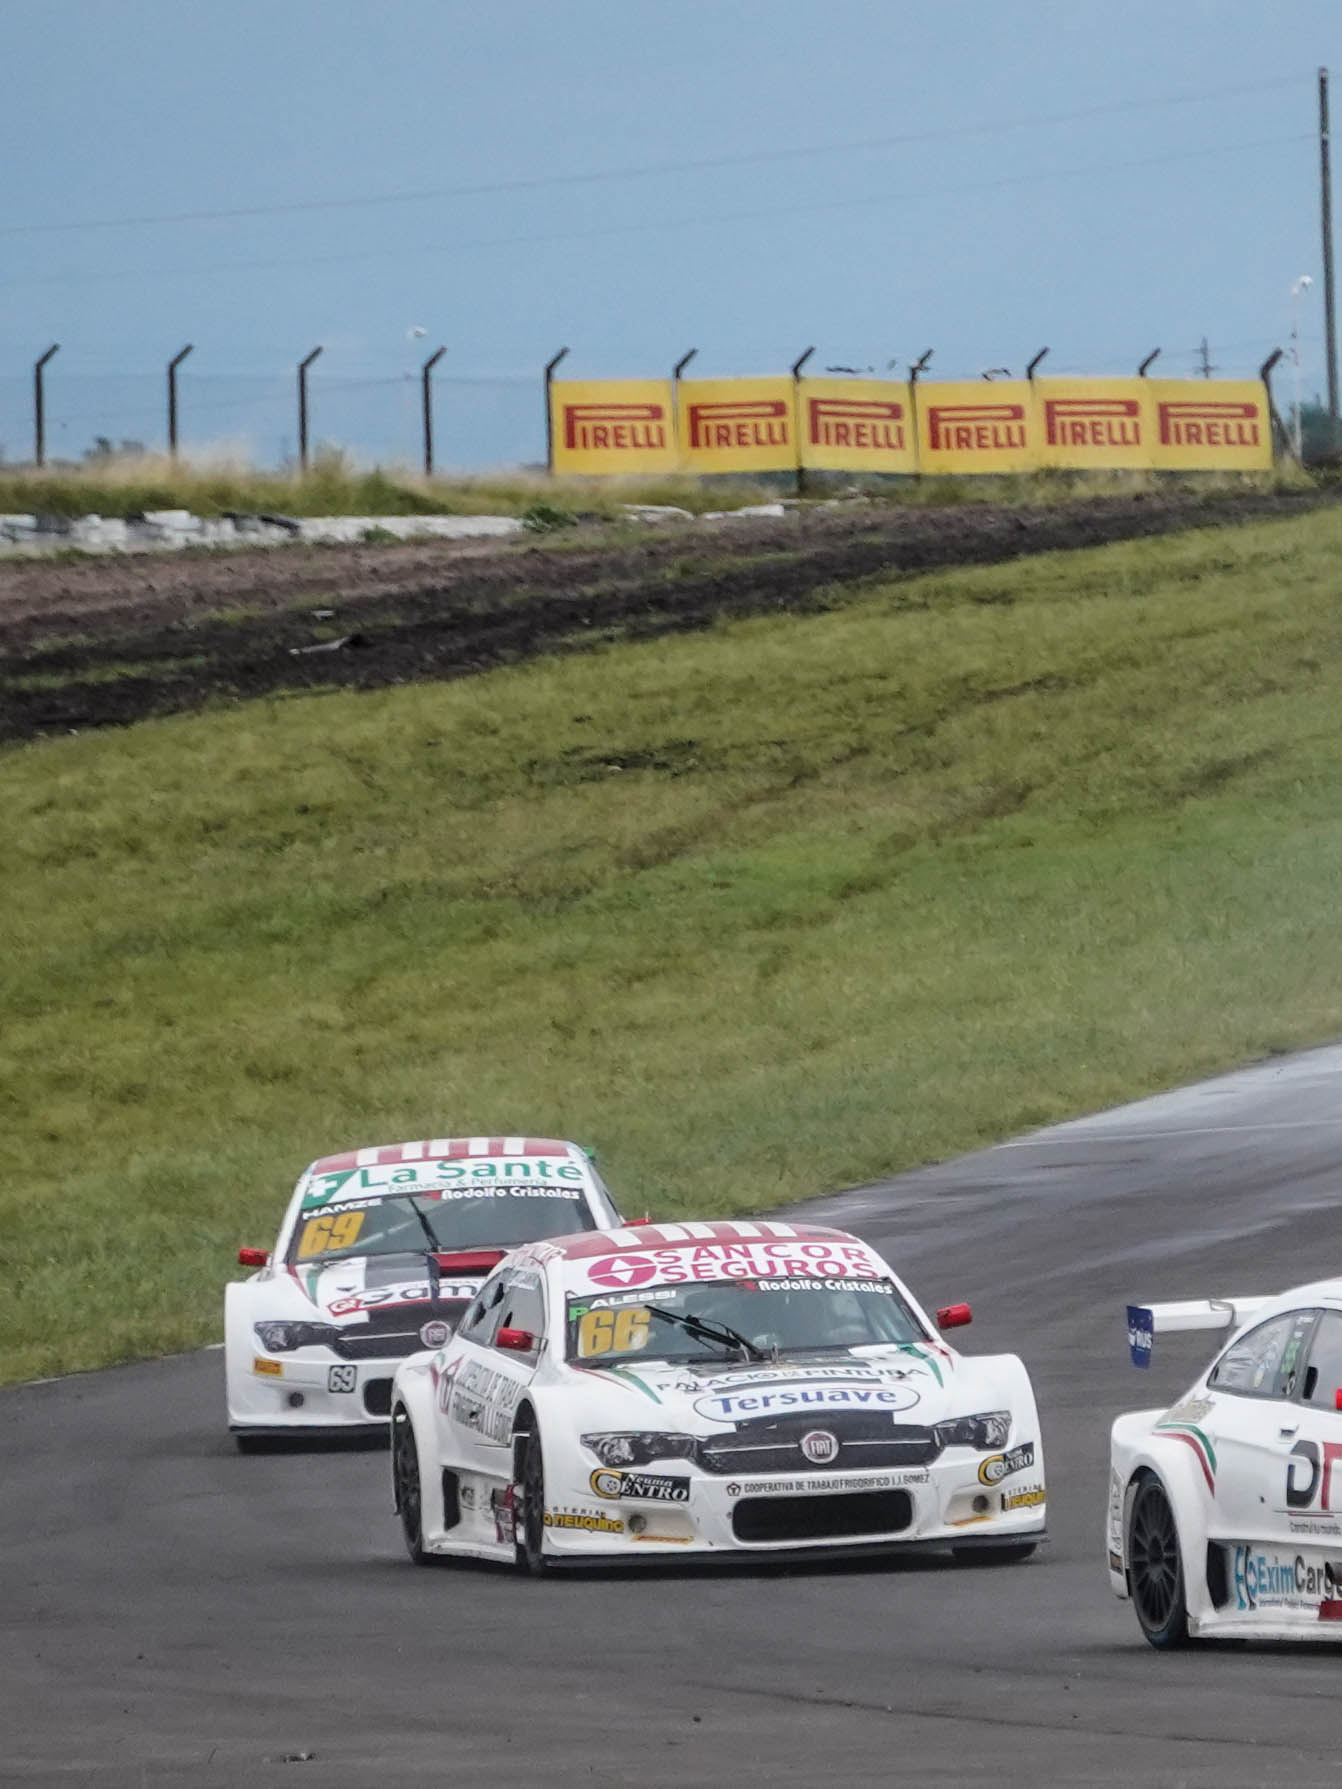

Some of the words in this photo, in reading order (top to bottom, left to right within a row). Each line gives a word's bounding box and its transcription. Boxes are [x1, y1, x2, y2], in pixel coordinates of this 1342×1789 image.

[563, 403, 665, 449] PIRELLI
[687, 401, 788, 448] PIRELLI
[807, 397, 905, 449] PIRELLI
[927, 404, 1026, 450] PIRELLI
[1044, 399, 1140, 446] PIRELLI
[1159, 402, 1259, 446] PIRELLI
[360, 1168, 418, 1188] La
[436, 1159, 583, 1181] Santé
[442, 1188, 506, 1201] Rodolfo
[511, 1187, 580, 1200] Cristales
[303, 1198, 382, 1220] HAMZE
[297, 1212, 365, 1257] 69
[654, 1244, 870, 1265] SANCOR
[656, 1259, 878, 1282] SEGUROS
[590, 1290, 676, 1309] ALESSI
[759, 1279, 822, 1292] Rodolfo
[826, 1280, 893, 1294] Cristales
[579, 1309, 650, 1358] 66
[331, 1366, 356, 1392] 69
[719, 1389, 898, 1413] Tersuave
[810, 1440, 832, 1456] FIAT
[744, 1481, 793, 1493] COOPERATIVA
[796, 1481, 805, 1490] DE
[807, 1479, 839, 1490] TRABAJO
[840, 1475, 889, 1488] FRIGORIFICO
